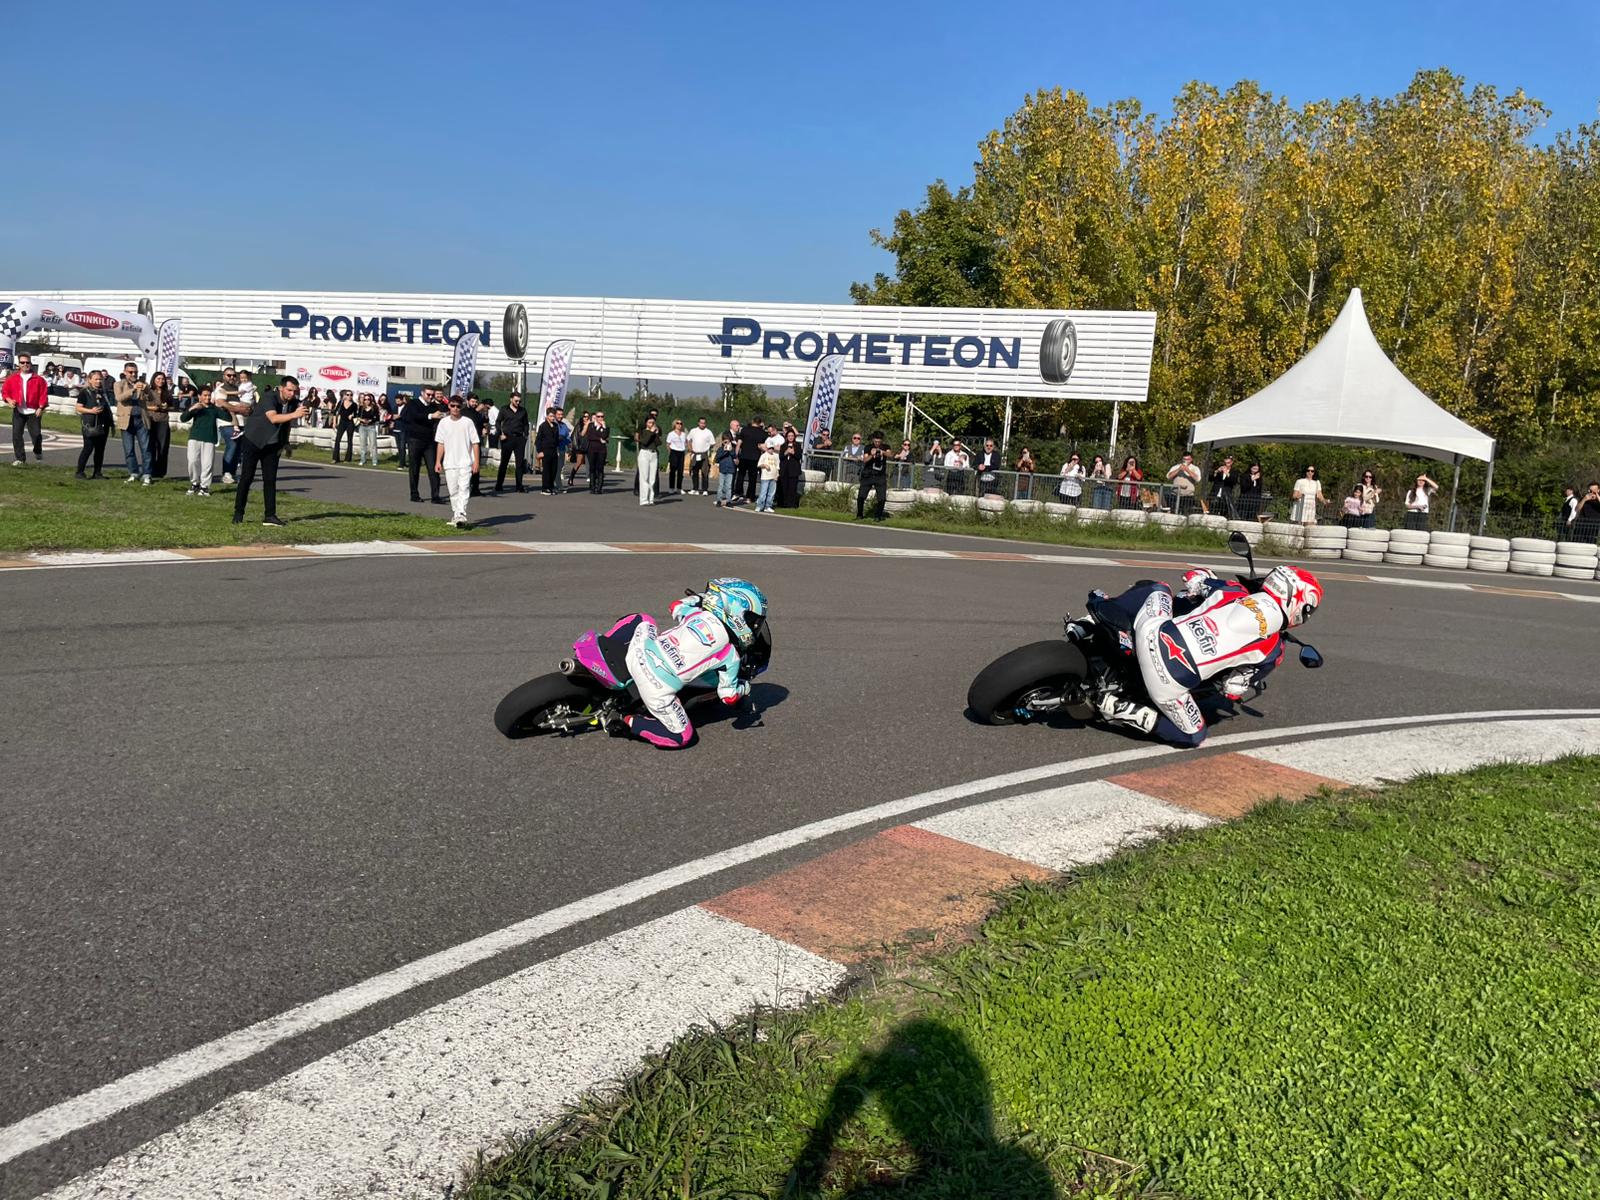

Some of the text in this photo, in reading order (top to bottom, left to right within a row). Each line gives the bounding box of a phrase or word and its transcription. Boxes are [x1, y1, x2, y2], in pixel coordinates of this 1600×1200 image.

[271, 304, 491, 347] PROMETEON
[707, 317, 1021, 368] PROMETEON
[659, 638, 685, 669] kefirix
[1187, 618, 1216, 655] kefir
[1186, 695, 1202, 726] kefir
